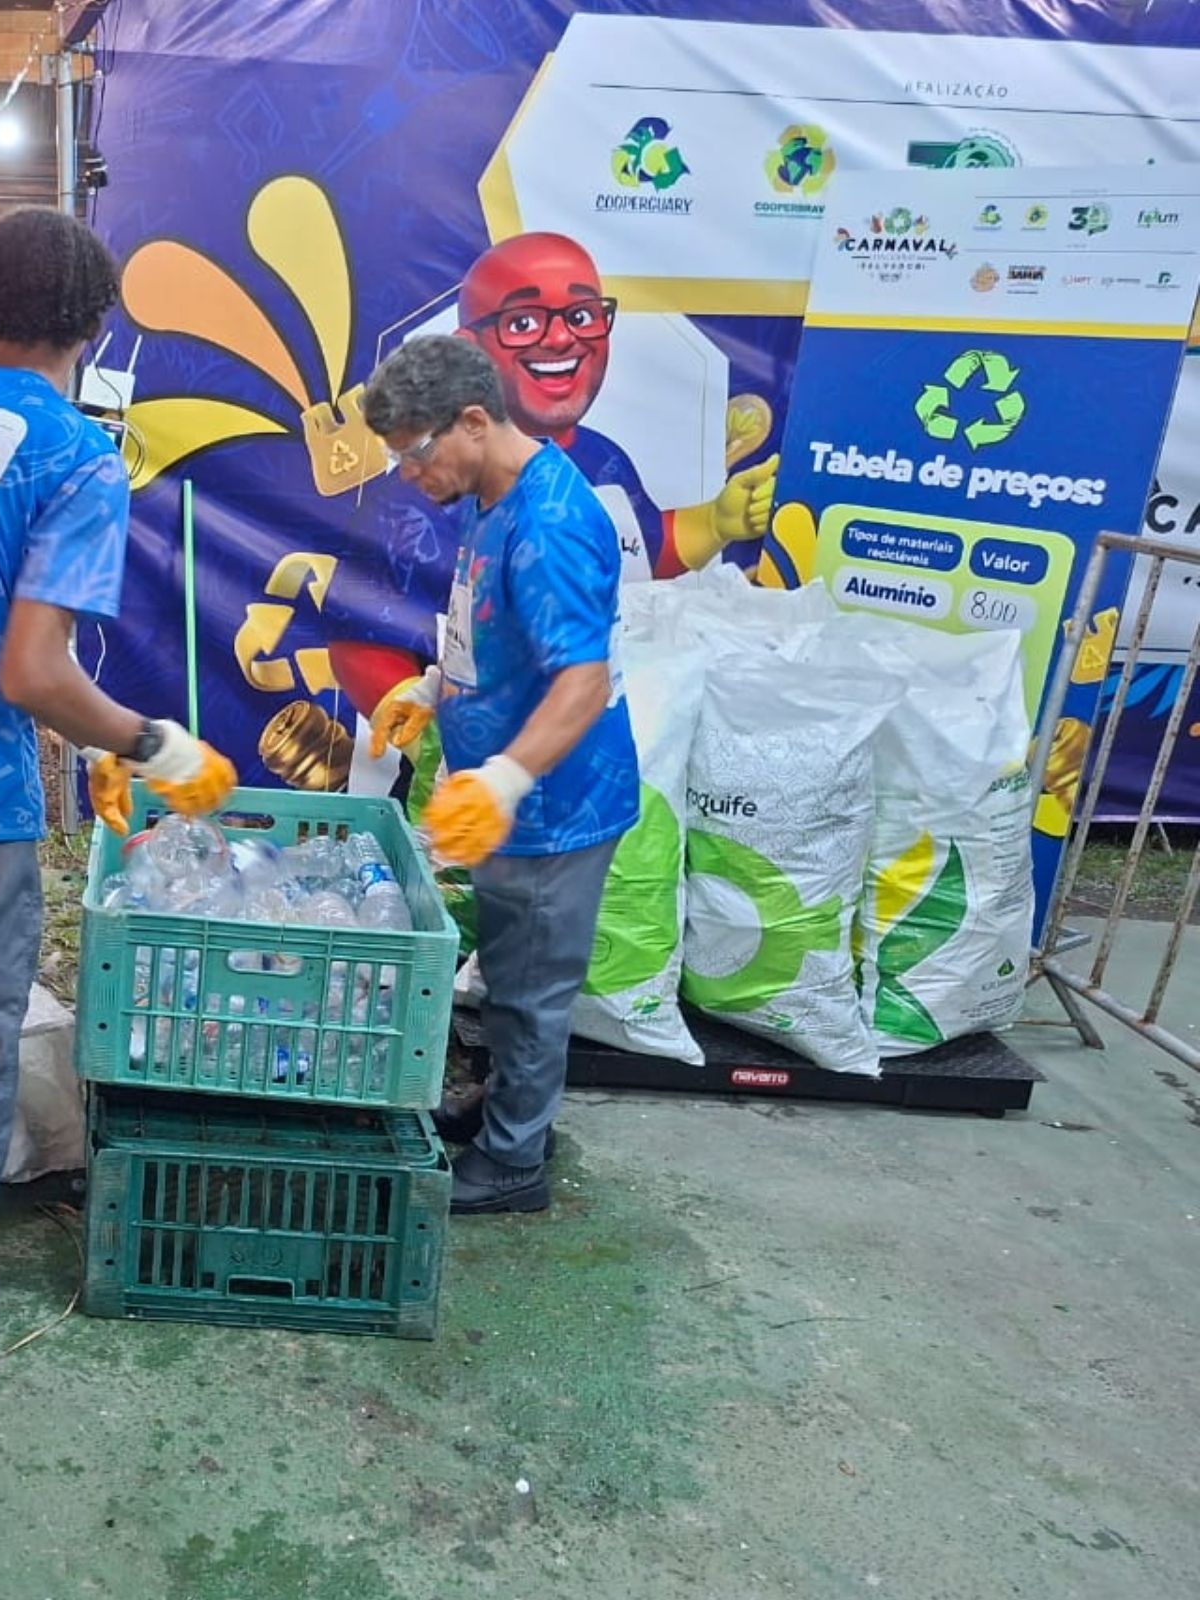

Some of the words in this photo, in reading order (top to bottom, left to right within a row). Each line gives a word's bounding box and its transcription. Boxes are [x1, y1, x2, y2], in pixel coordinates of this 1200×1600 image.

[596, 194, 693, 213] COOPERGUARY
[845, 238, 948, 252] CARNAVAL
[810, 441, 913, 483] Tabela
[919, 455, 963, 488] de
[967, 466, 1107, 508] preços:
[847, 527, 878, 543] Tipos
[881, 533, 897, 546] de
[899, 535, 954, 554] materiais
[867, 547, 930, 567] recicláveis
[981, 551, 1030, 574] Valor
[845, 576, 937, 608] Alumínio
[970, 591, 1018, 623] 8,00
[732, 1070, 789, 1086] navarro
